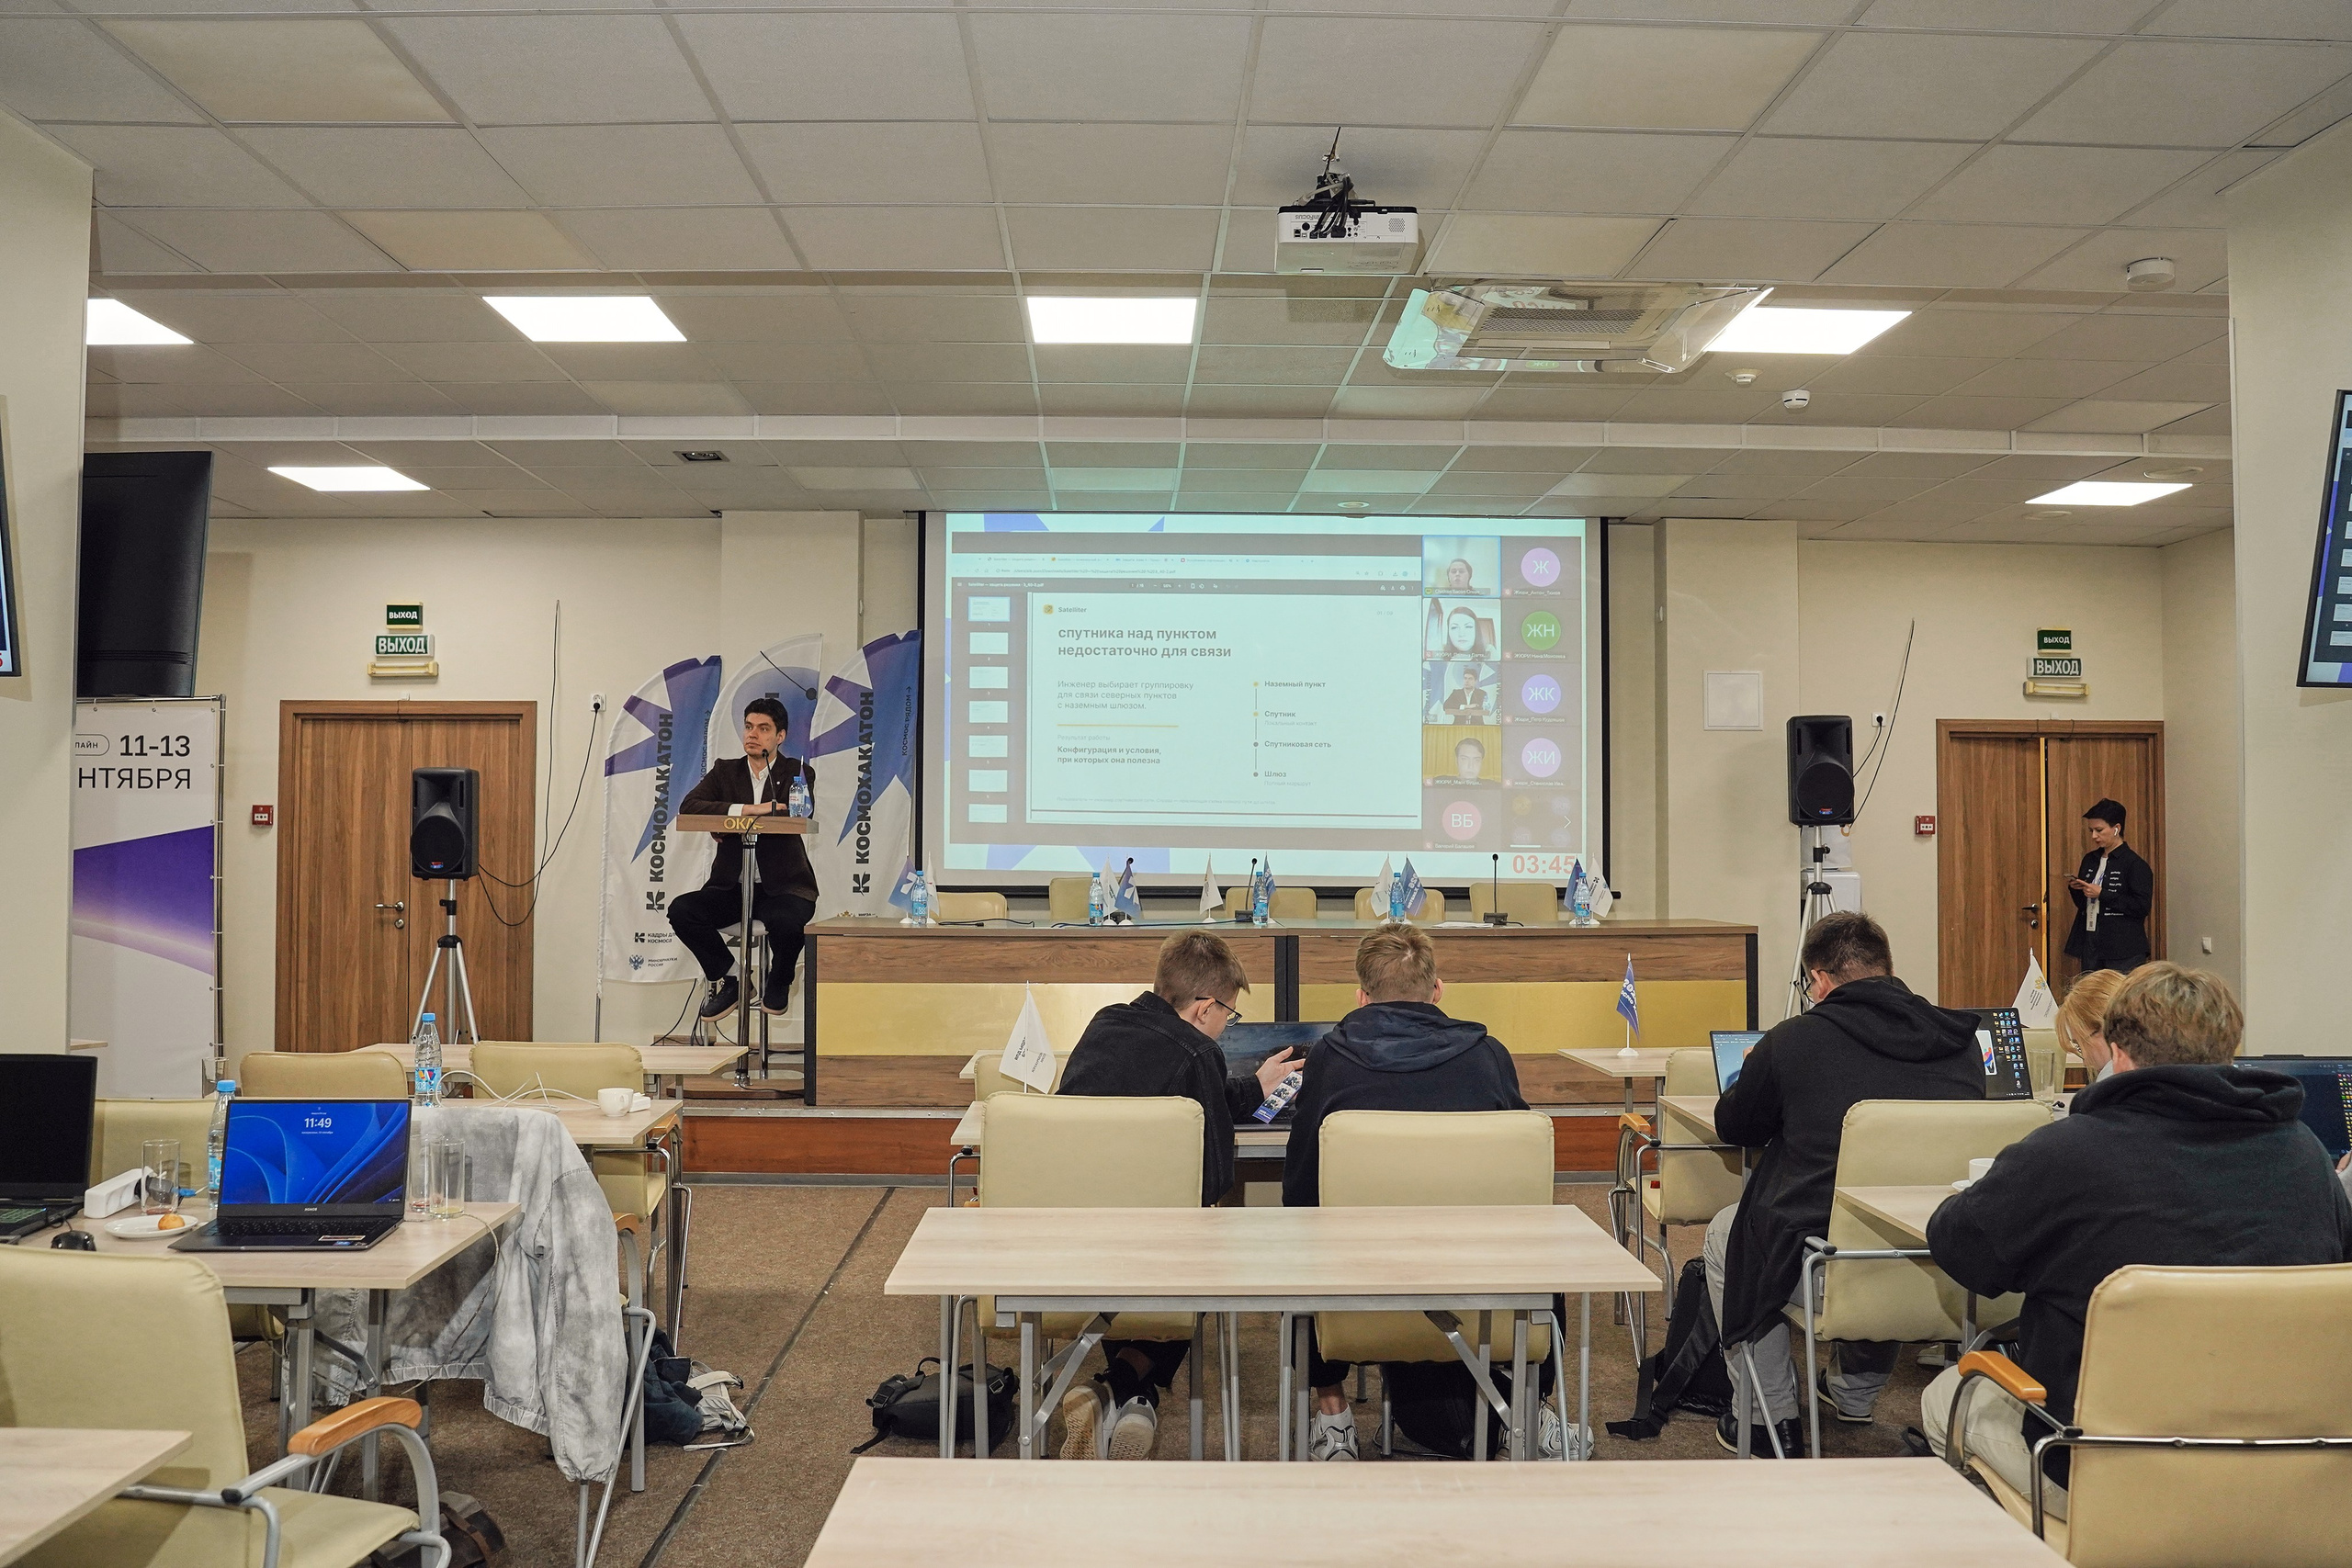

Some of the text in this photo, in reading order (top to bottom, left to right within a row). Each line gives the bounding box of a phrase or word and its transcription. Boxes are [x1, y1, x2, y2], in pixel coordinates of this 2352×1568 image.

[1532, 560, 1550, 574] Ж
[389, 611, 418, 620] ВЫХОД
[1058, 628, 1217, 641] спутника над пунктом
[1526, 624, 1555, 638] ЖН
[379, 637, 426, 654] ВЫХОД
[2043, 636, 2070, 645] ВЫХОД
[1058, 646, 1232, 659] недостаточно для связи
[2036, 660, 2080, 676] ВЫХОД
[1057, 680, 1194, 692] Инженер выбирает группировку
[1057, 692, 1073, 700] для
[1101, 693, 1142, 701] северных
[1144, 693, 1178, 702] пунктов
[1529, 687, 1555, 702] ЖК
[1065, 702, 1108, 710] наземным
[1264, 710, 1296, 719] Спутник
[119, 735, 191, 757] 11-13
[1057, 746, 1117, 755] Конфигурация
[1125, 748, 1162, 756] условия,
[1264, 740, 1314, 749] Спутниковая
[1057, 757, 1073, 765] при
[1073, 757, 1109, 765] которых
[1527, 750, 1555, 765] ЖИ
[78, 768, 191, 790] НТЯБРЯ
[856, 692, 874, 864] КОСМОХАКАТОН
[1264, 770, 1287, 778] Шлюз
[649, 713, 674, 883] КОСМОХАКАТОН
[1451, 813, 1474, 828] ВБ
[1512, 854, 1576, 874] 03:45
[303, 1117, 333, 1129] 11:49
